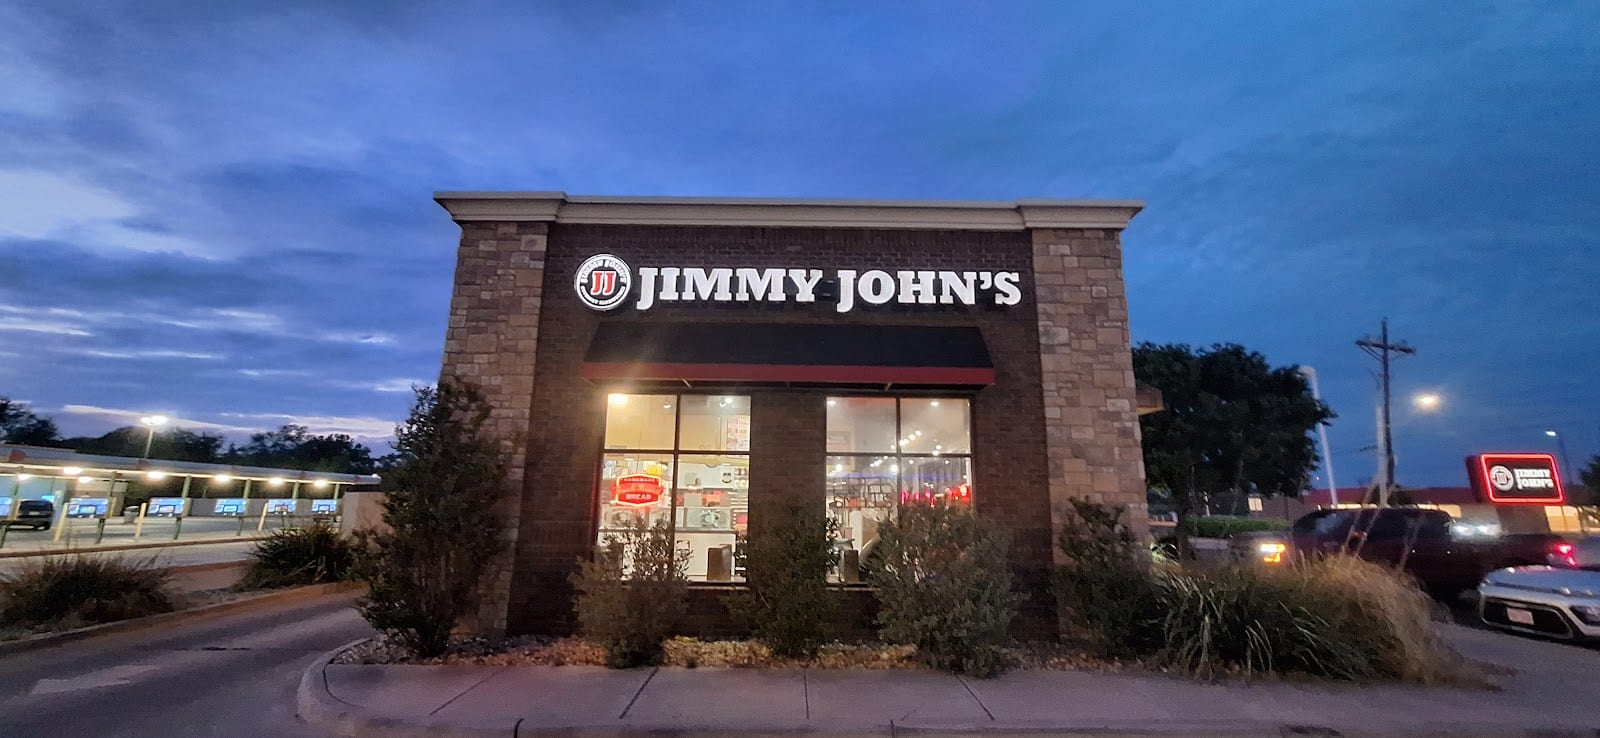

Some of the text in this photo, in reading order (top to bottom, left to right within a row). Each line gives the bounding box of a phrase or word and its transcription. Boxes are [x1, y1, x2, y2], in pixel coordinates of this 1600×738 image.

[590, 270, 617, 296] JJ
[636, 267, 823, 310] JIMMY
[836, 269, 1022, 313] JOHN'S
[1514, 468, 1550, 478] JIMMY
